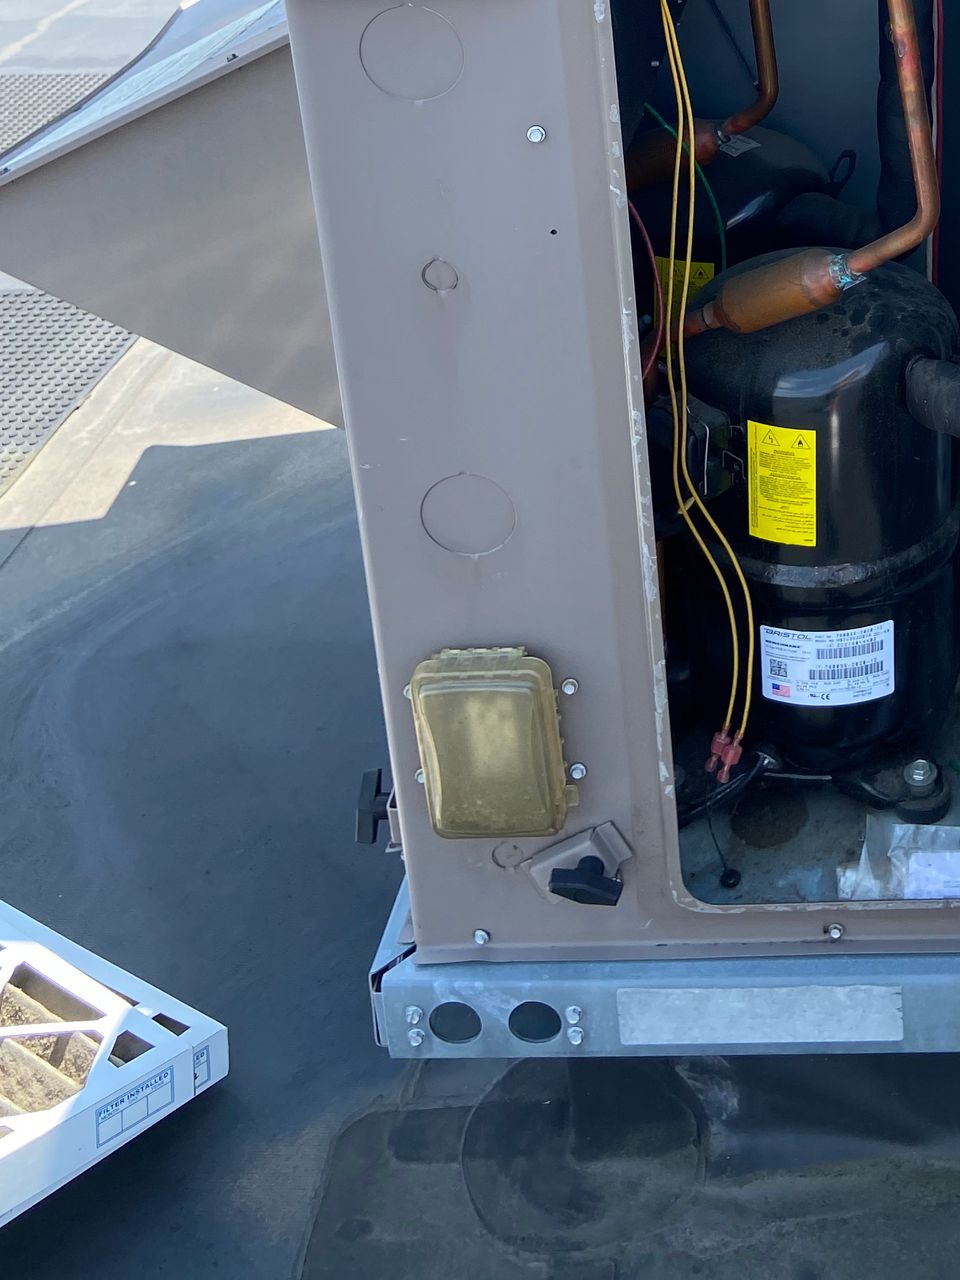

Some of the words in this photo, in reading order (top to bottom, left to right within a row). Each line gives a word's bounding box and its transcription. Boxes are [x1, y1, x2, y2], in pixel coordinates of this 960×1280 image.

[765, 628, 811, 640] BRISTOL
[99, 1098, 125, 1116] FILTER
[127, 1072, 169, 1100] INSTALLED
